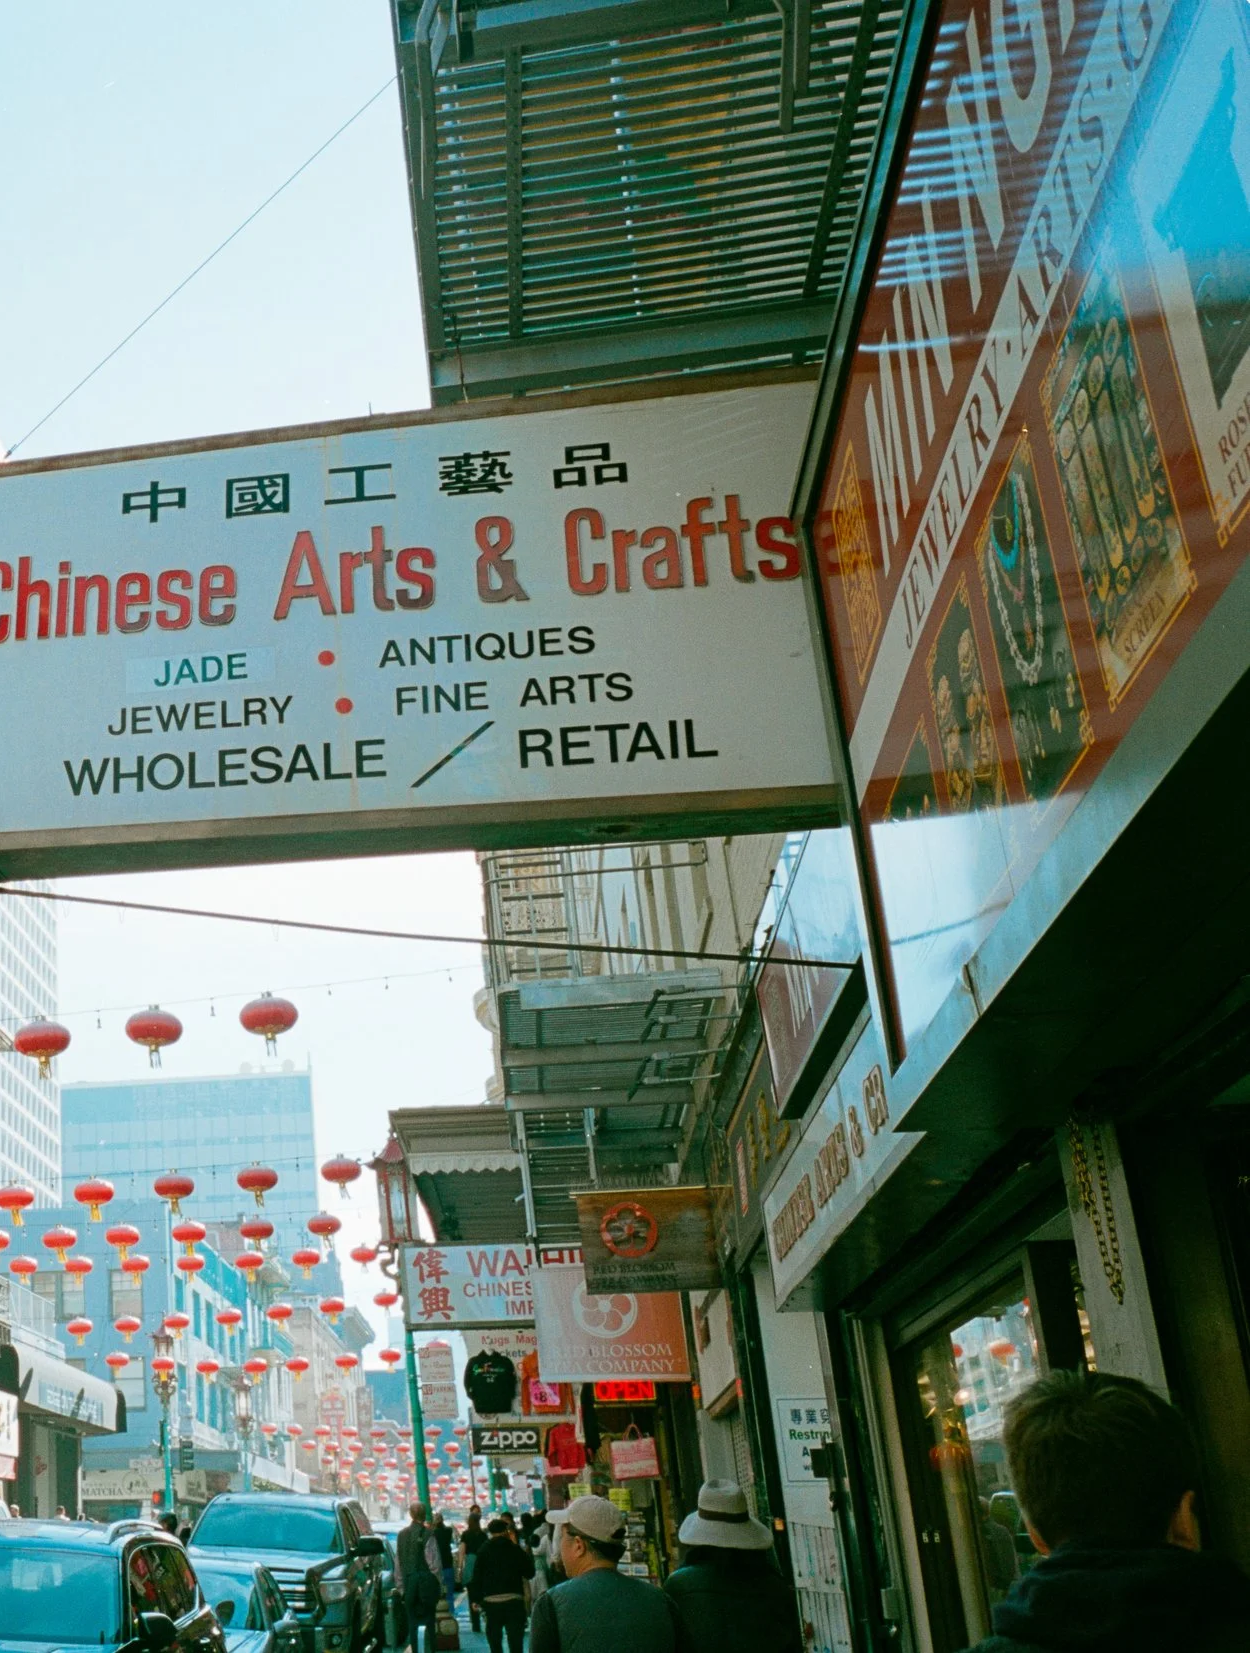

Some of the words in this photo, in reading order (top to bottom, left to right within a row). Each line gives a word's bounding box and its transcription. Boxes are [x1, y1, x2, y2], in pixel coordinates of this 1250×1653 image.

[121, 442, 629, 523] 中國工藝品
[273, 525, 436, 621] Arts
[474, 515, 530, 603] &
[564, 494, 803, 595] Crafts
[153, 652, 248, 688] JADE
[379, 626, 596, 668] ANTIQUES
[107, 695, 293, 736] JEWELRY
[396, 681, 490, 716] FINE
[519, 672, 634, 708] ARTS
[63, 738, 387, 797] WHOLESALE
[518, 718, 719, 769] RETAIL
[847, 1104, 865, 1158] &
[586, 1359, 675, 1373] COMPANY
[591, 1343, 673, 1357] BLOSSOM
[596, 1380, 653, 1399] OPEN
[81, 1487, 123, 1497] MATCHA
